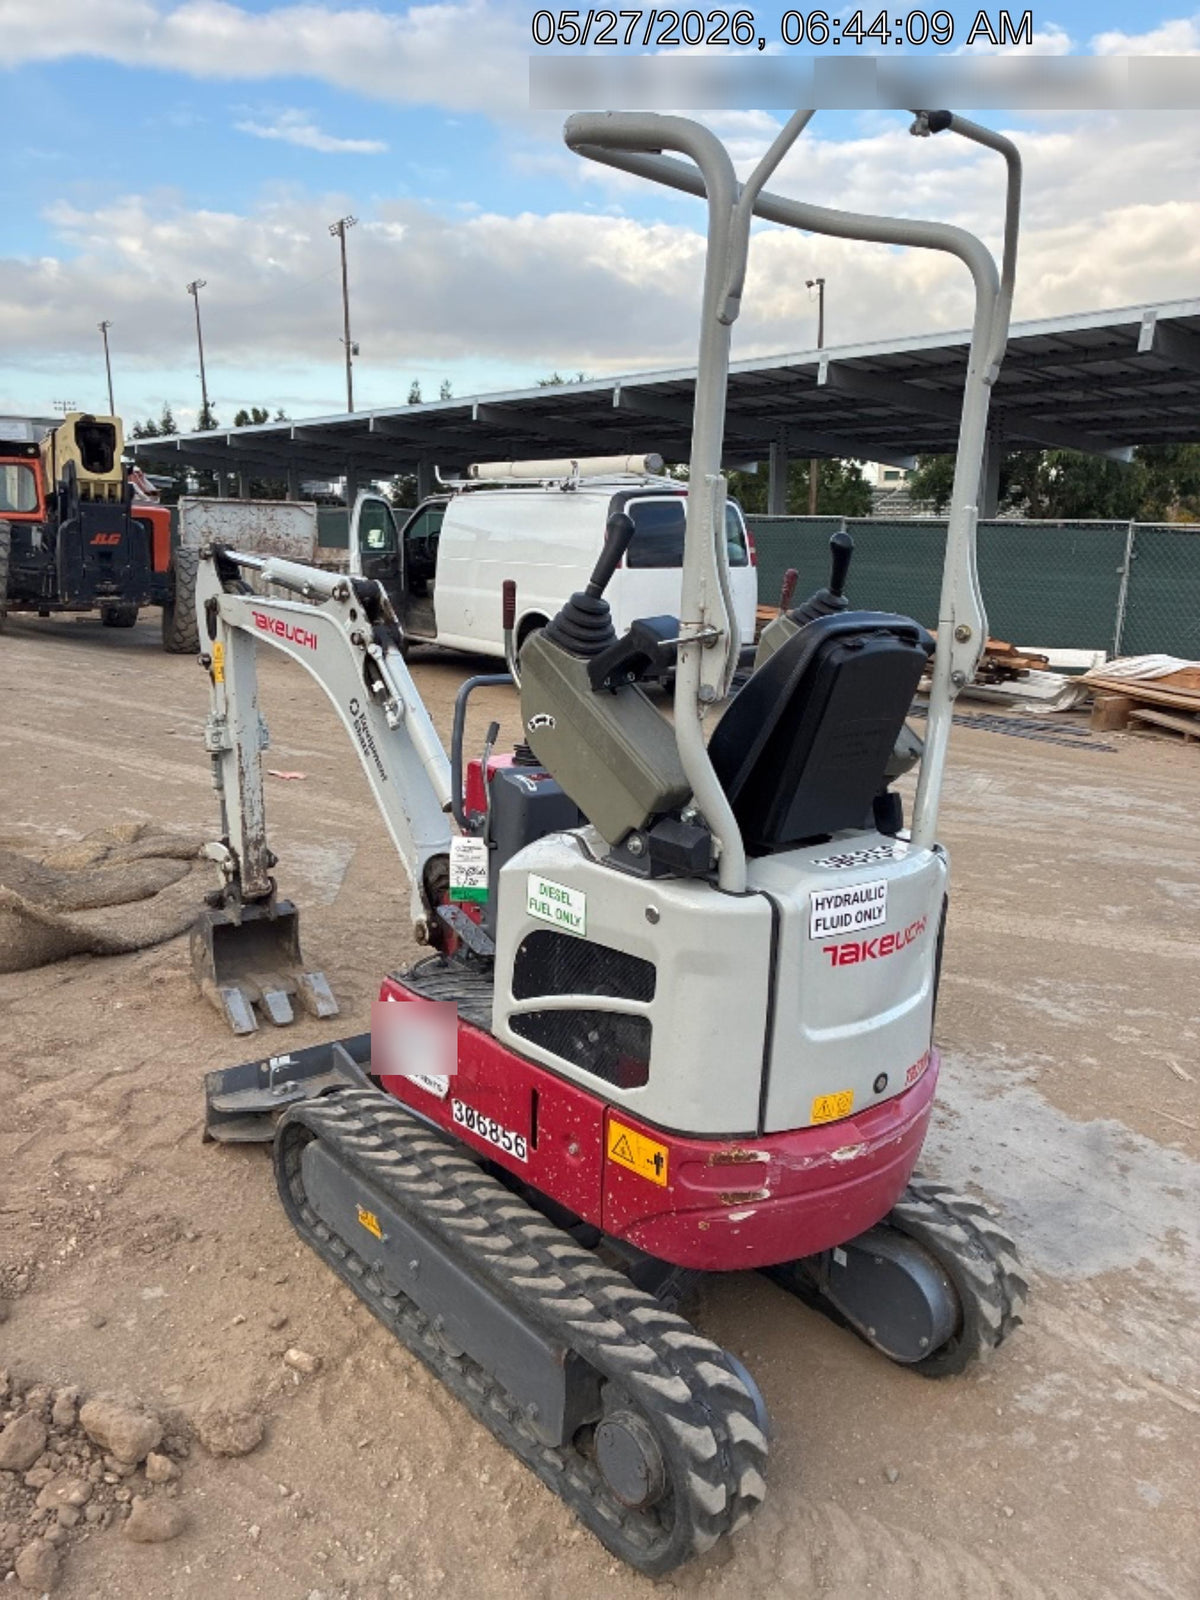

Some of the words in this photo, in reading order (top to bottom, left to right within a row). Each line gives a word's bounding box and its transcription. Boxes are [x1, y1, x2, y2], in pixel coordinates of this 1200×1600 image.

[90, 533, 121, 545] JLG
[539, 882, 572, 906] DIESEL
[815, 885, 885, 911] HYDRAULIC
[529, 897, 553, 917] FUEL
[556, 907, 582, 926] ONLY
[815, 913, 852, 932] FLUID
[855, 904, 884, 923] ONLY
[454, 1100, 526, 1158] 306856
